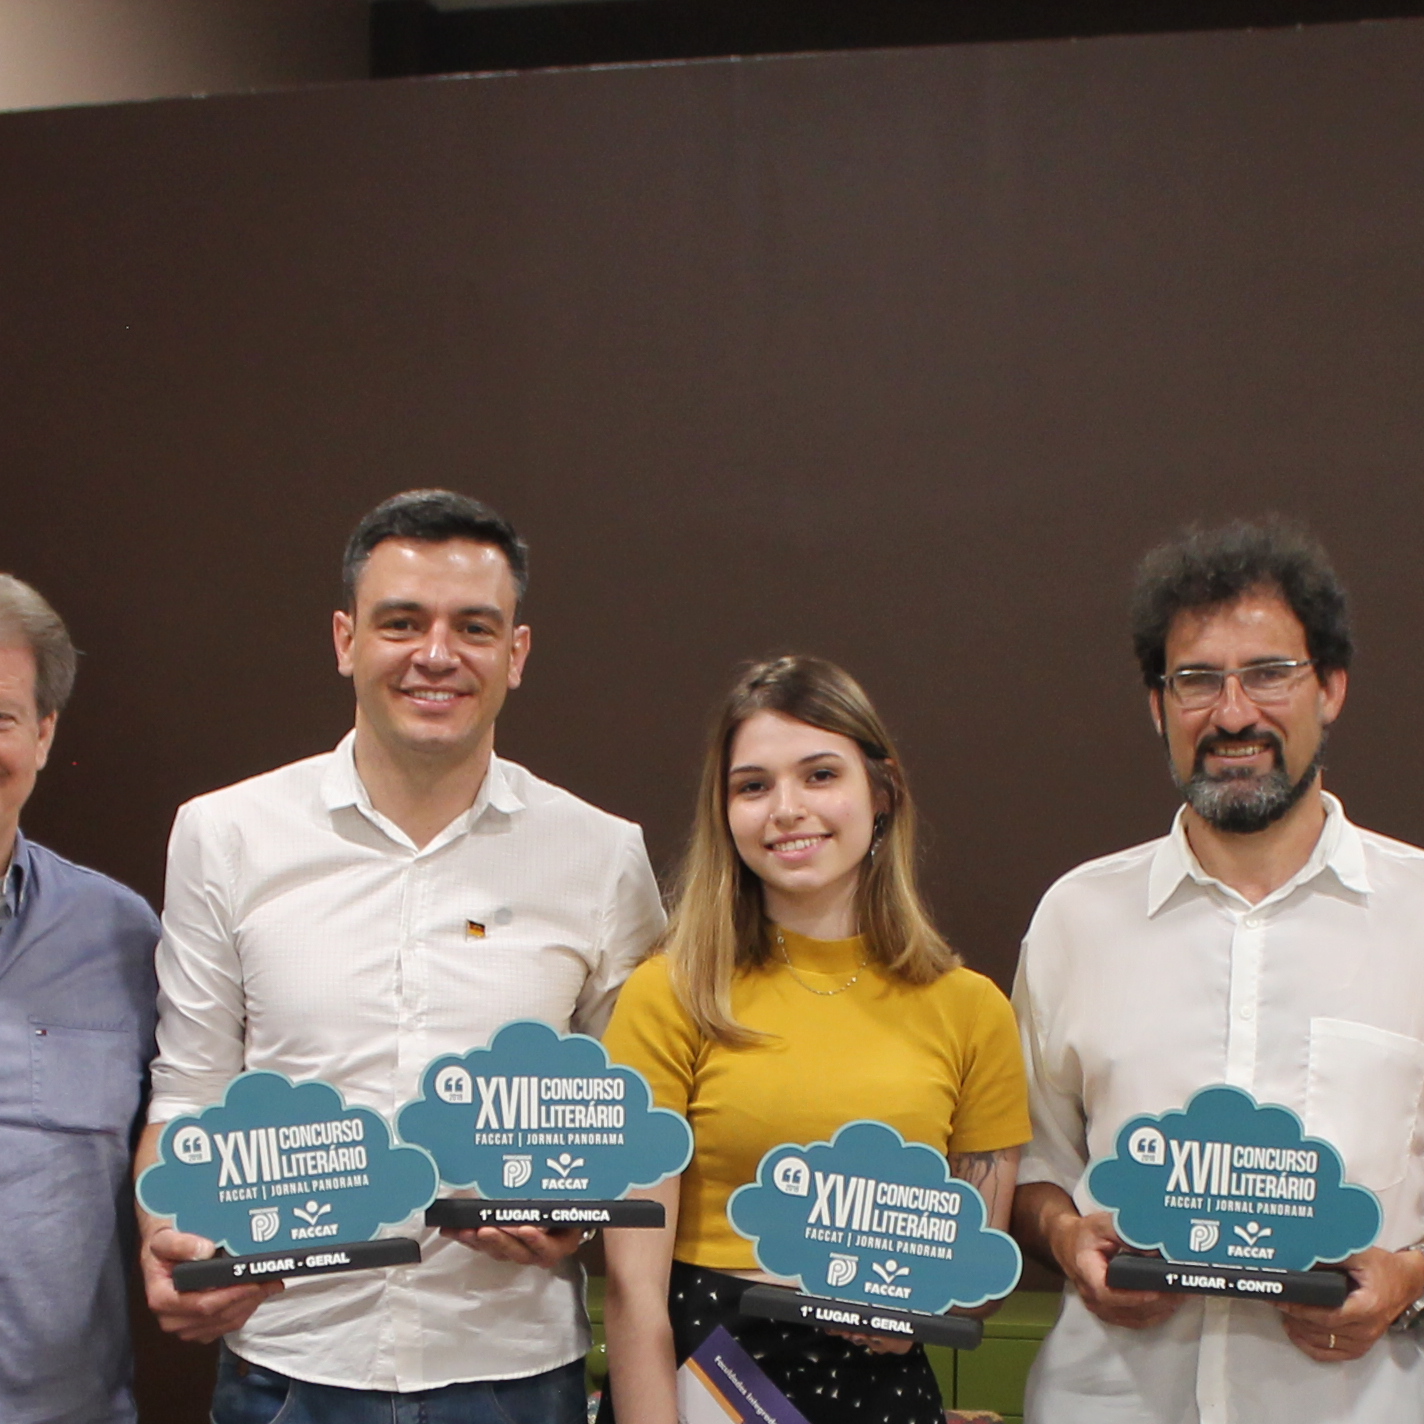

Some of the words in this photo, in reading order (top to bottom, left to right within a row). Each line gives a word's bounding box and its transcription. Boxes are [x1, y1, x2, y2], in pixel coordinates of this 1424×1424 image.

[476, 1076, 538, 1130] XVII
[541, 1078, 624, 1100] CONCURSO
[541, 1101, 624, 1129] LITERÁRIO
[279, 1118, 363, 1149] CONCURSO
[475, 1133, 514, 1145] FACCAT
[526, 1133, 565, 1146] JORNAL
[568, 1133, 624, 1146] PANORAMA
[214, 1127, 279, 1187] XVII
[282, 1145, 367, 1178] LITERÁRIO
[1166, 1139, 1231, 1196] XVII
[1233, 1145, 1318, 1174] CONCURSO
[219, 1187, 257, 1203] FACCAT
[271, 1183, 310, 1197] JORNAL
[313, 1174, 369, 1193] PANORAMA
[541, 1178, 589, 1190] FACCAT
[1231, 1172, 1316, 1201] LITERÁRIO
[807, 1171, 876, 1232] XVII
[876, 1182, 961, 1216] CONCURSO
[1165, 1195, 1204, 1210] FACCAT
[1215, 1199, 1253, 1214] JORNAL
[1257, 1202, 1314, 1218] PANORAMA
[496, 1209, 540, 1221] LUGAR
[552, 1206, 610, 1222] CRÔNICA
[874, 1208, 958, 1243] LITERÁRIO
[291, 1224, 339, 1240] FACCAT
[805, 1227, 844, 1244] FACCAT
[855, 1235, 894, 1252] JORNAL
[896, 1241, 953, 1260] PANORAMA
[250, 1259, 294, 1274] LUGAR
[306, 1252, 350, 1269] GERAL
[1228, 1245, 1275, 1259] FACCAT
[864, 1282, 912, 1299] FACCAT
[1182, 1274, 1226, 1290] LUGAR
[1237, 1279, 1283, 1294] CONTO
[816, 1308, 860, 1326] LUGAR
[871, 1317, 914, 1334] GERAL
[713, 1354, 749, 1395] Faculdades
